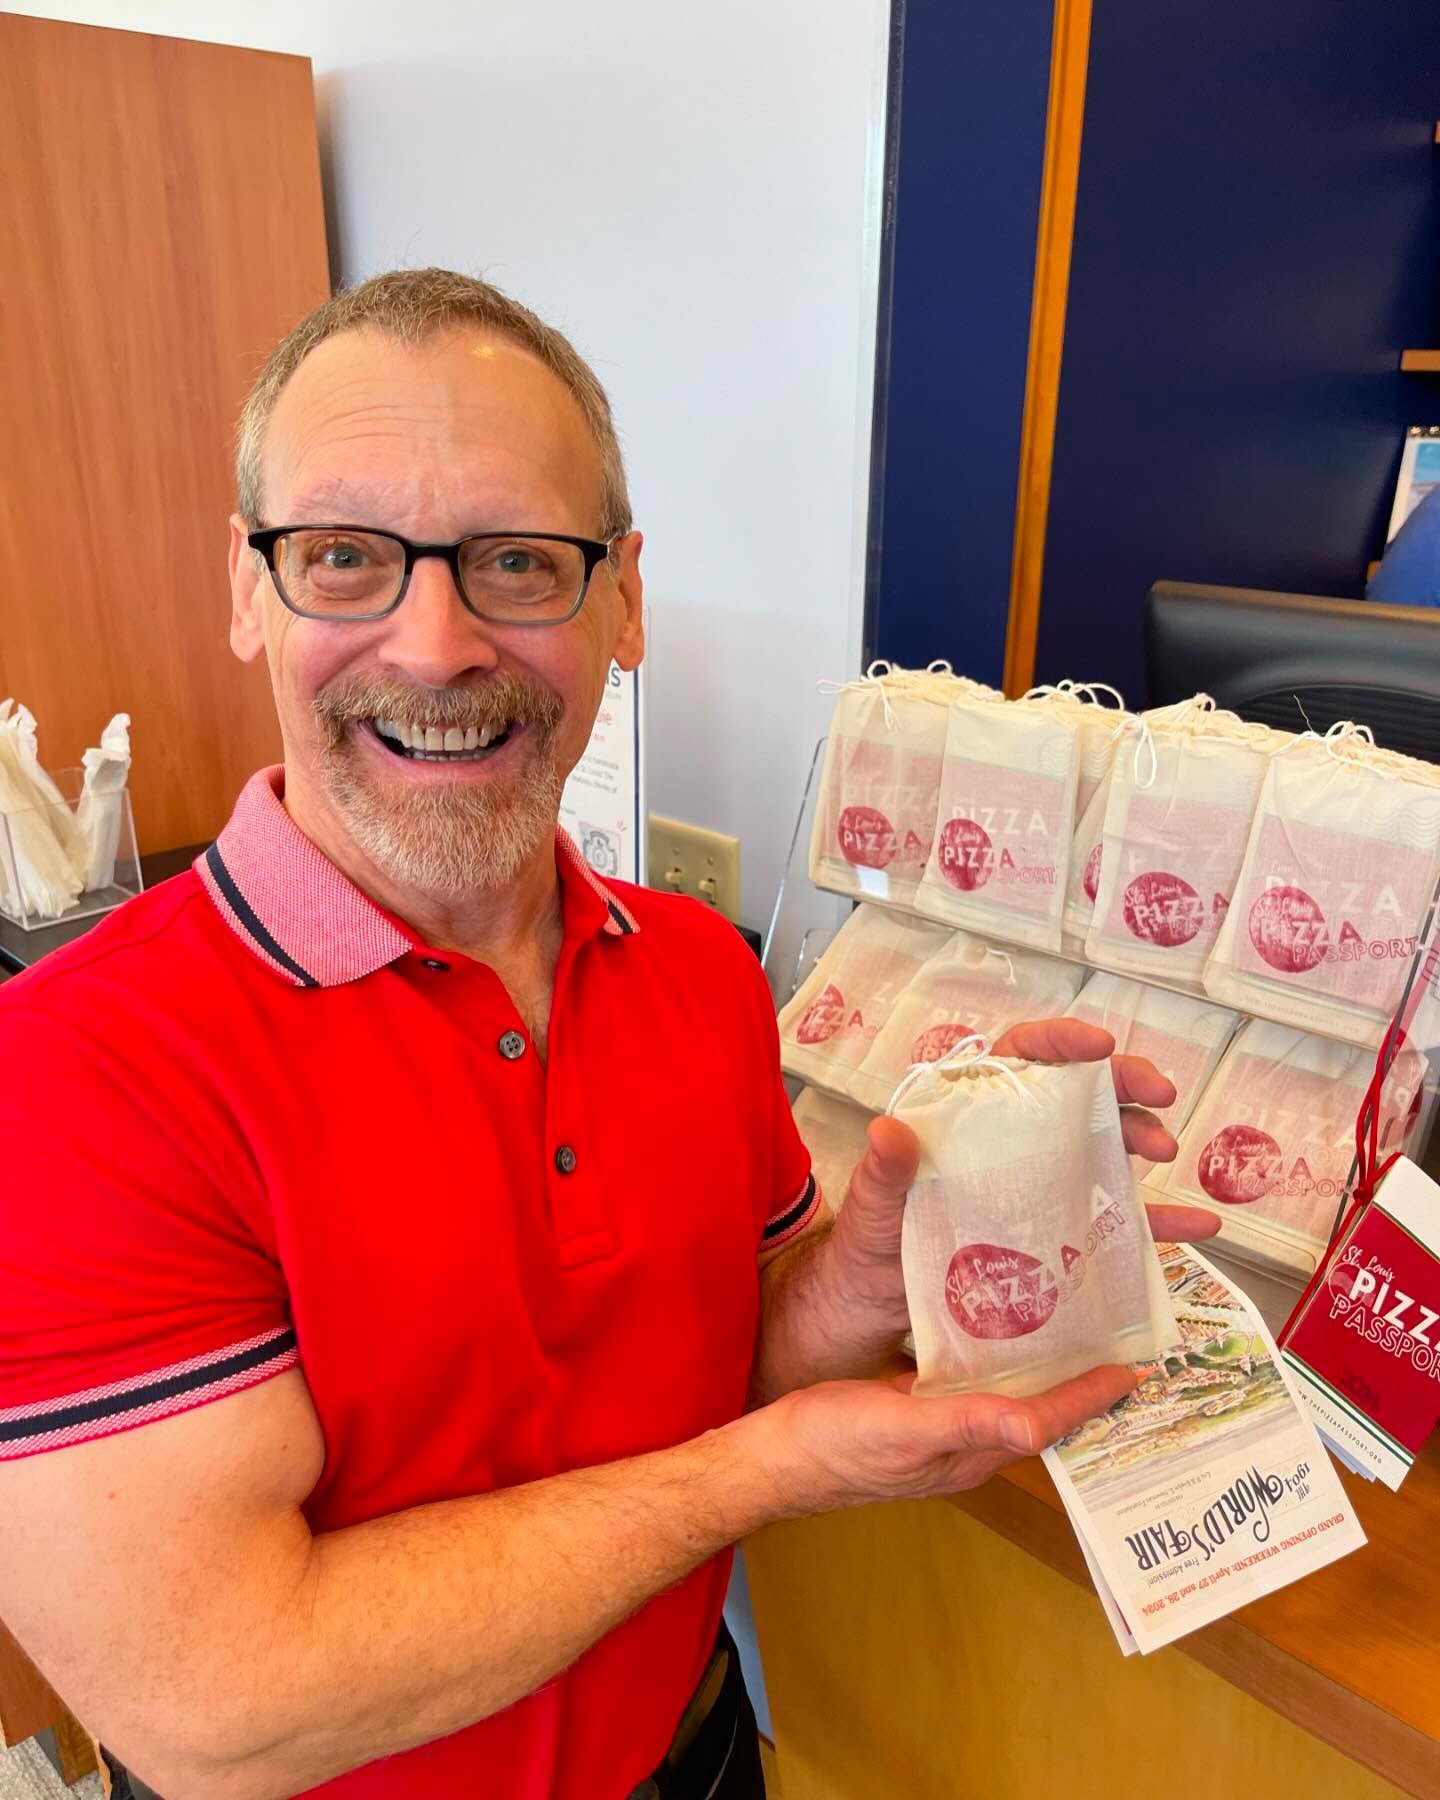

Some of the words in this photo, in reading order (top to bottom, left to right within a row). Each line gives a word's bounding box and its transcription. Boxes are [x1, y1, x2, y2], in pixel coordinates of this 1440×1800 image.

[843, 829, 922, 851] PIZZA
[944, 846, 1016, 869] PIZZA
[1132, 892, 1230, 930] PIZZA
[1260, 918, 1363, 946] PIZZA
[1292, 935, 1419, 964] PASSPORT
[1207, 1154, 1313, 1181] PIZZA
[972, 1255, 1019, 1281] Louis
[1343, 1245, 1361, 1268] St.
[1364, 1256, 1396, 1283] Louis
[959, 1245, 1081, 1323] PIZZA
[1348, 1267, 1440, 1352] PIZZ
[1284, 1461, 1311, 1492] 1904
[1191, 1464, 1284, 1562] WORLD'S
[1317, 1512, 1345, 1532] GRAND
[1124, 1518, 1193, 1572] FAIR
[1279, 1526, 1318, 1551] OPENING
[1183, 1557, 1200, 1570] Free
[1230, 1543, 1281, 1574] WEEKEND:
[1147, 1564, 1185, 1588] Admission!
[1198, 1577, 1210, 1589] 27
[1208, 1566, 1232, 1585] April
[1165, 1592, 1180, 1606] 28,
[1179, 1583, 1197, 1599] and
[1142, 1598, 1167, 1617] 2024
